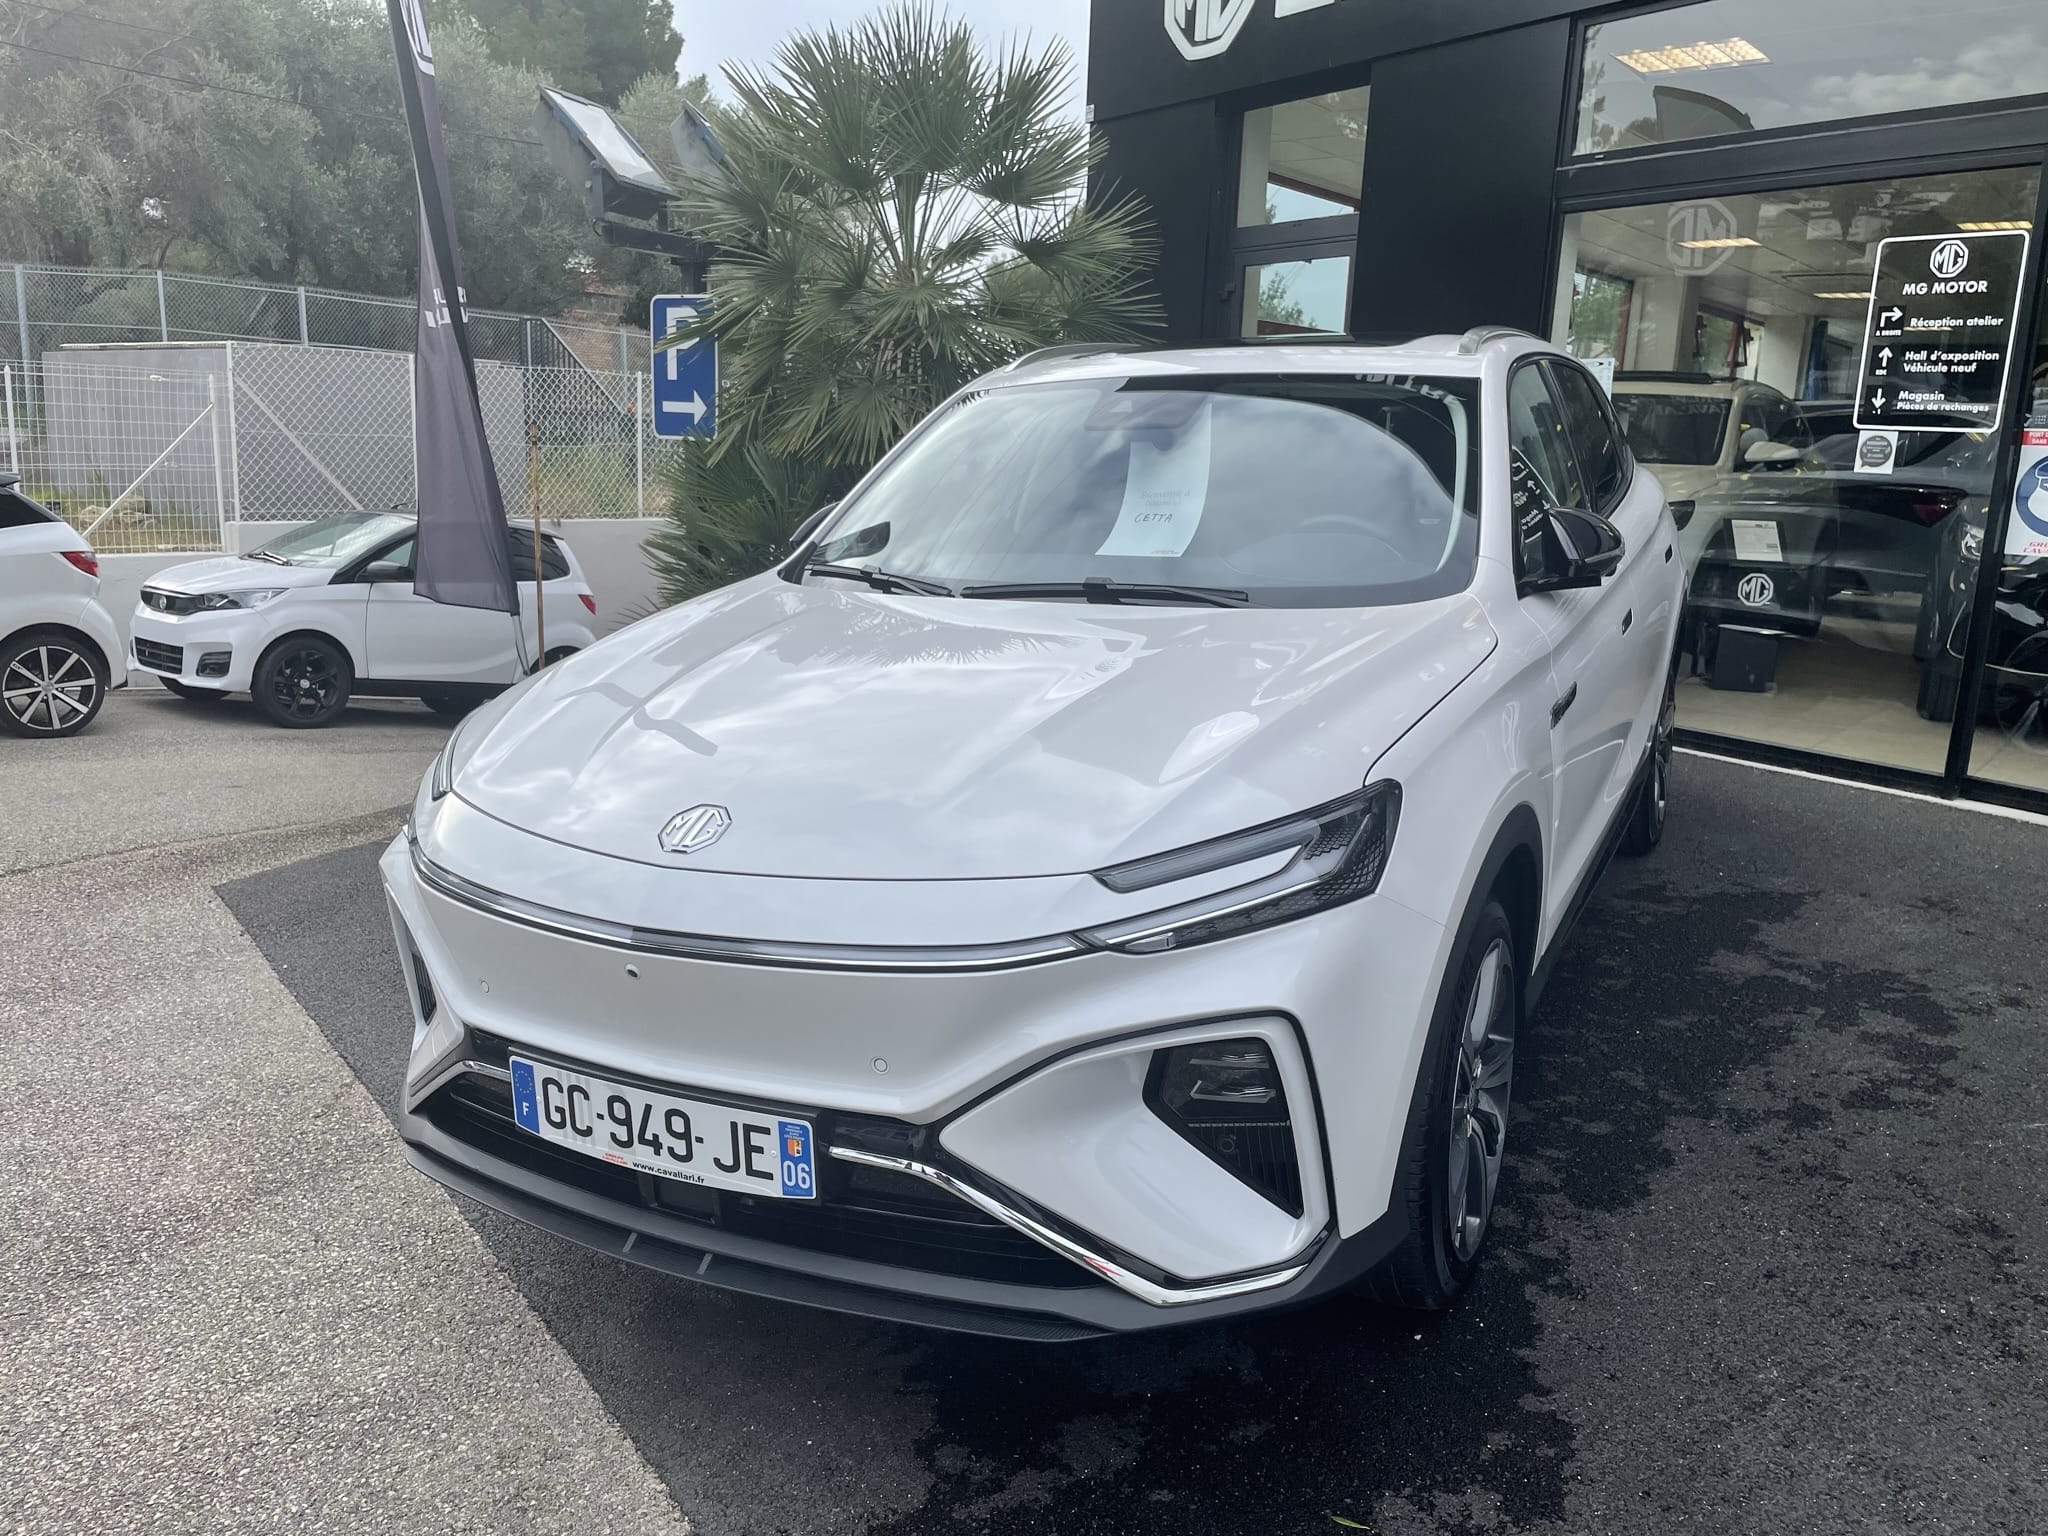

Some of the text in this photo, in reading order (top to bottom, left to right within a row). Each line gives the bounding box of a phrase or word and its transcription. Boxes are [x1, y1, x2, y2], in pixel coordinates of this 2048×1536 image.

[1932, 242, 1966, 276] MG
[1902, 280, 1988, 295] MG MOTOR
[1910, 315, 2004, 329] Réception atelier
[666, 307, 701, 380] P
[1905, 350, 2000, 363] Hall d'exposition
[1903, 362, 1977, 373] Véhicule neuf
[1898, 391, 1945, 402] Magasin
[1896, 401, 1989, 413] Pièces de rechanges
[1740, 575, 1772, 605] MG
[662, 806, 729, 850] MG
[522, 1101, 530, 1116] F
[632, 1160, 705, 1184] www.cavallari.fr
[783, 1161, 810, 1189] 06
